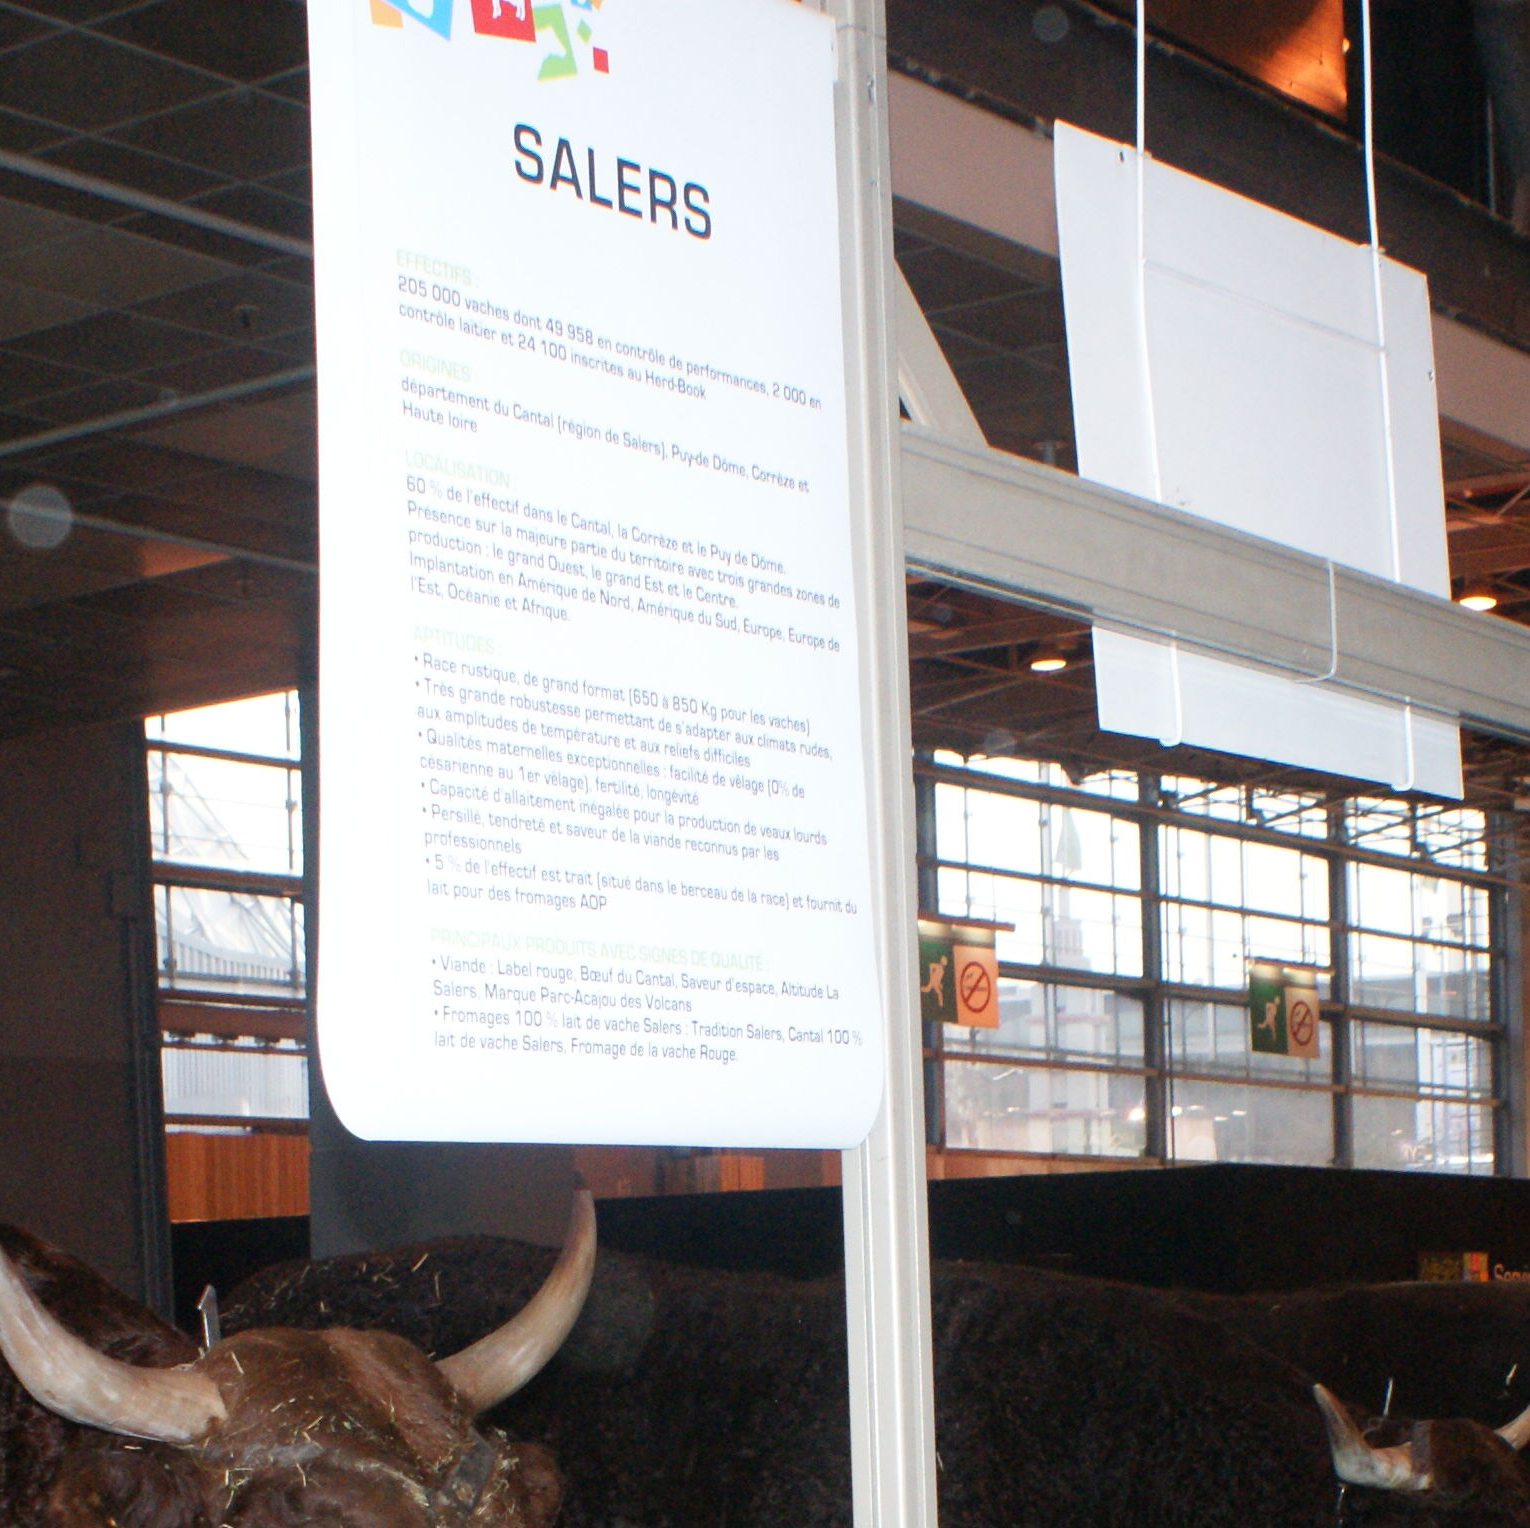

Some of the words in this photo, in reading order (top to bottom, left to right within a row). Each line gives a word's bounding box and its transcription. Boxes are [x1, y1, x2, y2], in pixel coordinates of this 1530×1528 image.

[513, 123, 712, 240] SALERS
[396, 248, 472, 286] EFFECTIFS
[397, 273, 428, 299] 205
[431, 282, 461, 308] 000
[464, 297, 510, 322] vaches
[512, 308, 543, 332] dont
[545, 317, 564, 337] 49
[566, 322, 594, 347] 958
[597, 335, 613, 352] en
[668, 354, 683, 372] de
[686, 361, 770, 398] performances,
[772, 381, 781, 399] 2
[783, 383, 807, 407] 000
[809, 396, 822, 411] en
[459, 316, 498, 342] laitier
[500, 331, 515, 347] et
[517, 332, 537, 353] 24
[540, 339, 567, 362] 100
[570, 351, 624, 378] inscrites
[627, 367, 642, 383] au
[399, 349, 471, 383] ORIGINES
[402, 399, 444, 425] Haute
[448, 410, 478, 433] loire
[493, 399, 510, 417] du
[512, 402, 555, 429] Cantal
[604, 427, 620, 446] de
[797, 479, 810, 494] et
[405, 447, 510, 489] LOCALISATION
[410, 575, 444, 600] l'Est,
[504, 596, 518, 612] et
[521, 596, 571, 623] Afrique.
[413, 625, 495, 655] APTITUDES
[422, 651, 457, 674] Race
[461, 663, 520, 686] rustique,
[523, 670, 539, 688] de
[542, 676, 579, 695] grand
[582, 679, 626, 703] format
[672, 695, 698, 715] 850
[701, 699, 718, 722] Kg
[720, 707, 748, 723] pour
[749, 708, 766, 727] les
[459, 687, 506, 707] grande
[509, 693, 581, 719] robustesse
[584, 707, 656, 731] permettant
[657, 716, 673, 734] de
[675, 719, 732, 744] s'adapter
[734, 731, 755, 747] aux
[757, 733, 797, 754] climats
[799, 742, 833, 761] rudes,
[486, 740, 563, 763] maternelles
[566, 752, 661, 778] exceptionnelles
[712, 770, 727, 787] de
[791, 783, 806, 800] de
[497, 767, 514, 781] au
[518, 765, 541, 784] 1er
[492, 786, 576, 813] d'allaitement
[633, 809, 662, 825] pour
[664, 808, 675, 826] la
[678, 814, 741, 834] production
[743, 820, 758, 837] de
[759, 825, 792, 841] veaux
[793, 826, 828, 847] lourds
[424, 830, 523, 855] professionnels
[427, 878, 450, 897] lait
[452, 884, 484, 901] pour
[488, 884, 512, 903] des
[514, 886, 577, 912] fromages
[579, 893, 608, 912] AOP
[432, 978, 482, 1000] Salers,
[484, 982, 537, 1006] Marque
[620, 992, 642, 1009] des
[644, 993, 693, 1013] Volcans
[440, 954, 486, 975] Viande
[497, 959, 532, 977] Label
[535, 965, 577, 985] rouge,
[616, 968, 633, 985] du
[635, 969, 678, 990] Cantal,
[680, 972, 723, 991] Saveur
[724, 977, 779, 998] d'espace,
[780, 980, 824, 1000] Altitude
[826, 983, 840, 1001] La
[442, 1005, 511, 1030] Fromages
[515, 1009, 543, 1028] 100
[561, 1011, 583, 1030] lait
[585, 1014, 601, 1031] de
[603, 1015, 640, 1033] vache
[643, 1017, 683, 1036] Salers
[690, 1019, 744, 1039] Tradition
[745, 1023, 786, 1044] Salers,
[787, 1025, 824, 1044] Cantal
[826, 1027, 850, 1046] 100
[434, 1030, 456, 1049] lait
[460, 1031, 476, 1049] de
[479, 1033, 519, 1052] vache
[522, 1034, 567, 1055] Salers,
[570, 1036, 627, 1061] Fromage
[629, 1040, 645, 1057] de
[648, 1041, 659, 1058] la
[661, 1043, 697, 1060] vache
[699, 1043, 739, 1066] Rouge.
